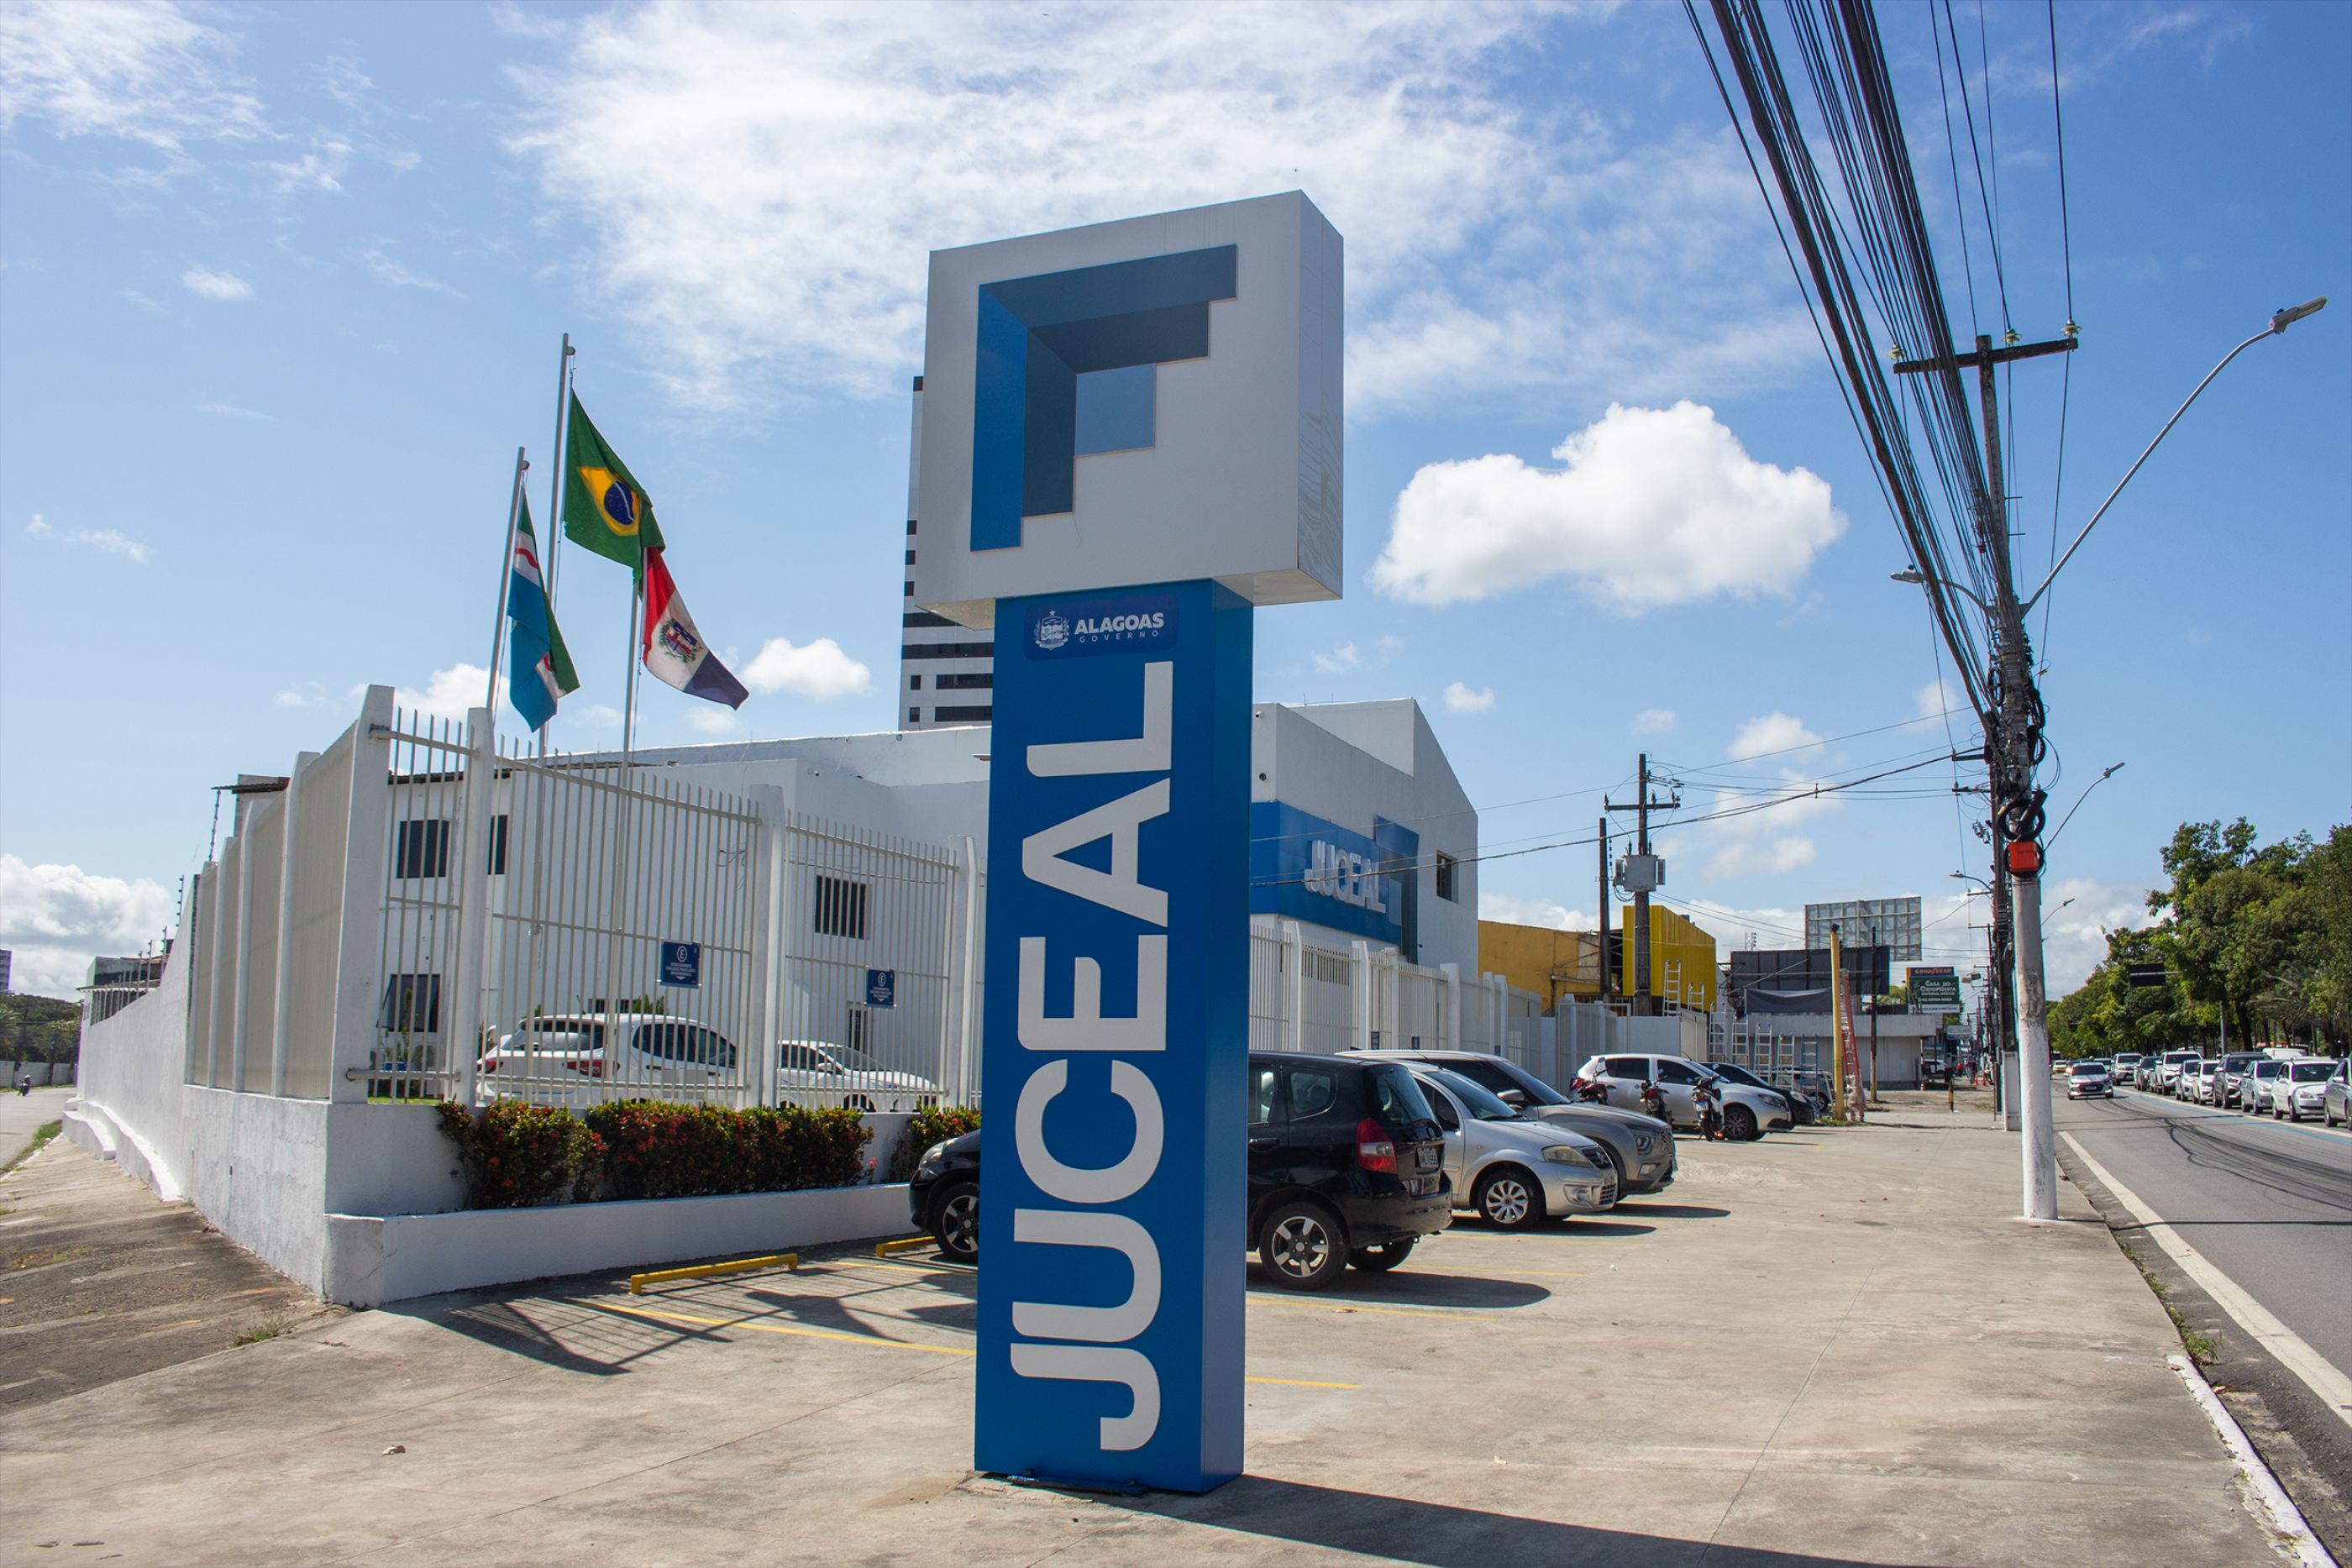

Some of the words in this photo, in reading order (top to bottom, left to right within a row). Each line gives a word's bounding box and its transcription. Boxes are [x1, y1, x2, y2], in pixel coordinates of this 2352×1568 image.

[1074, 612, 1164, 635] ALAGOAS
[1079, 630, 1159, 643] GOVERNO
[1304, 840, 1386, 914] JUCEAL
[1010, 660, 1173, 1452] JUCEAL
